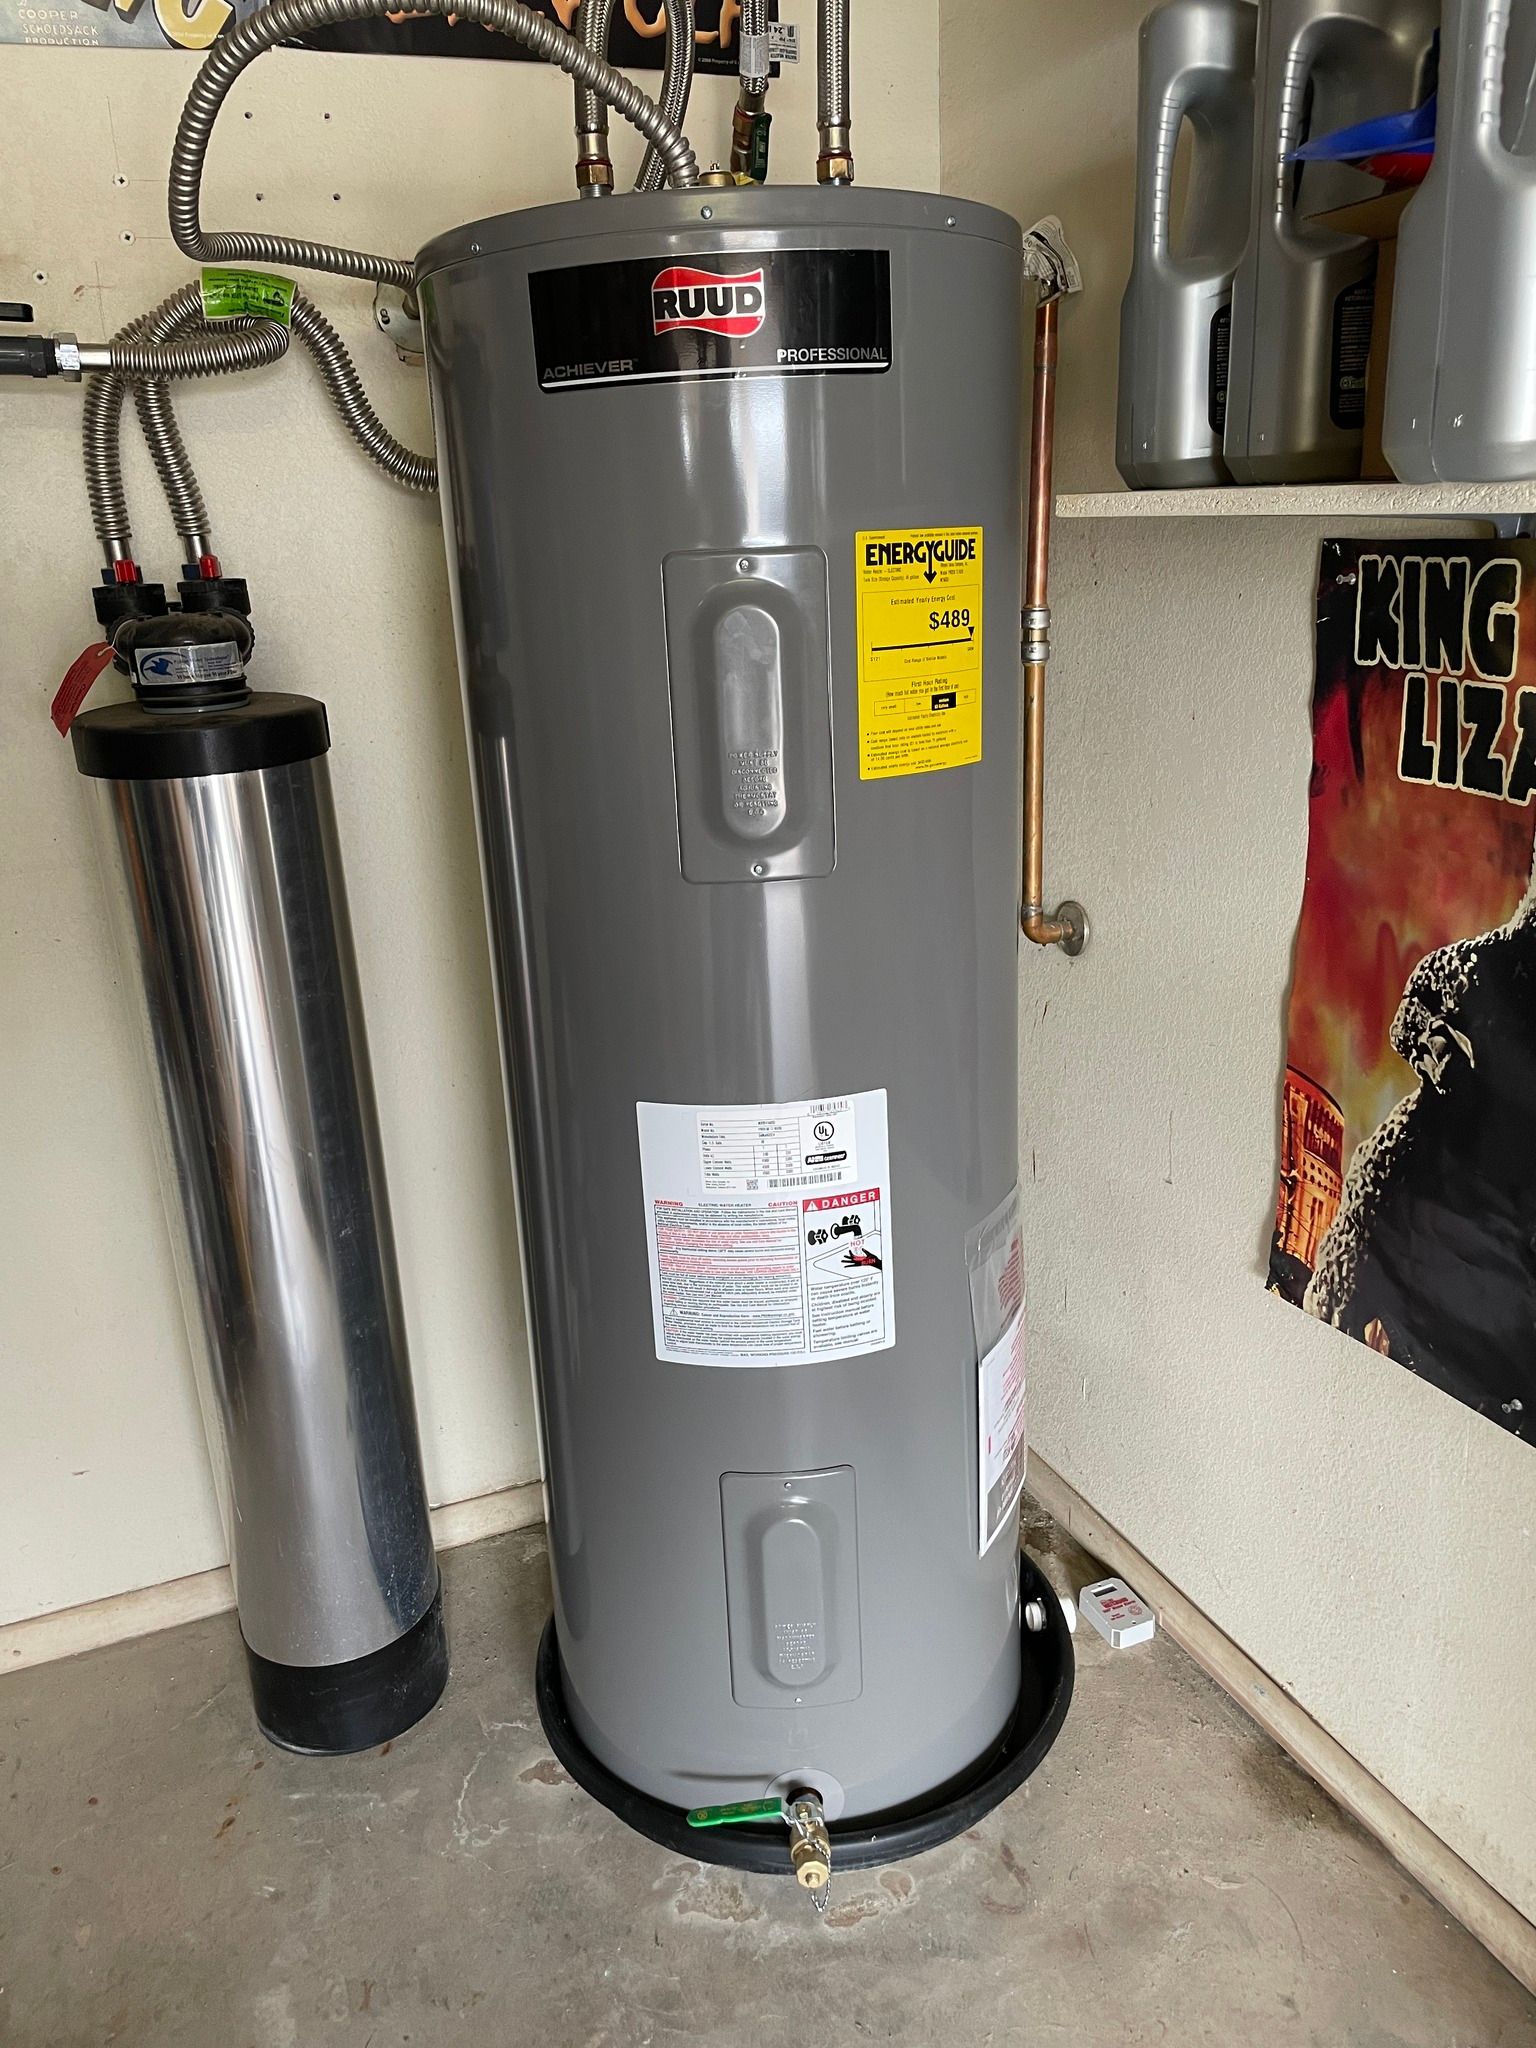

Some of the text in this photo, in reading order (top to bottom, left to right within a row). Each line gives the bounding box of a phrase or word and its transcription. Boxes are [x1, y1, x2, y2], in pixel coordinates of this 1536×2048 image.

[18, 9, 79, 20] COOPER
[22, 23, 99, 36] SCHOEDSACK
[25, 37, 99, 46] PRODUCTION
[654, 286, 763, 320] RUUD
[776, 347, 887, 363] PROFESSIONAL
[543, 359, 633, 380] ACHIEVER
[929, 609, 970, 631] $489
[1354, 554, 1522, 683] KING
[654, 1199, 683, 1207] WARNING
[821, 1191, 876, 1209] DANGER
